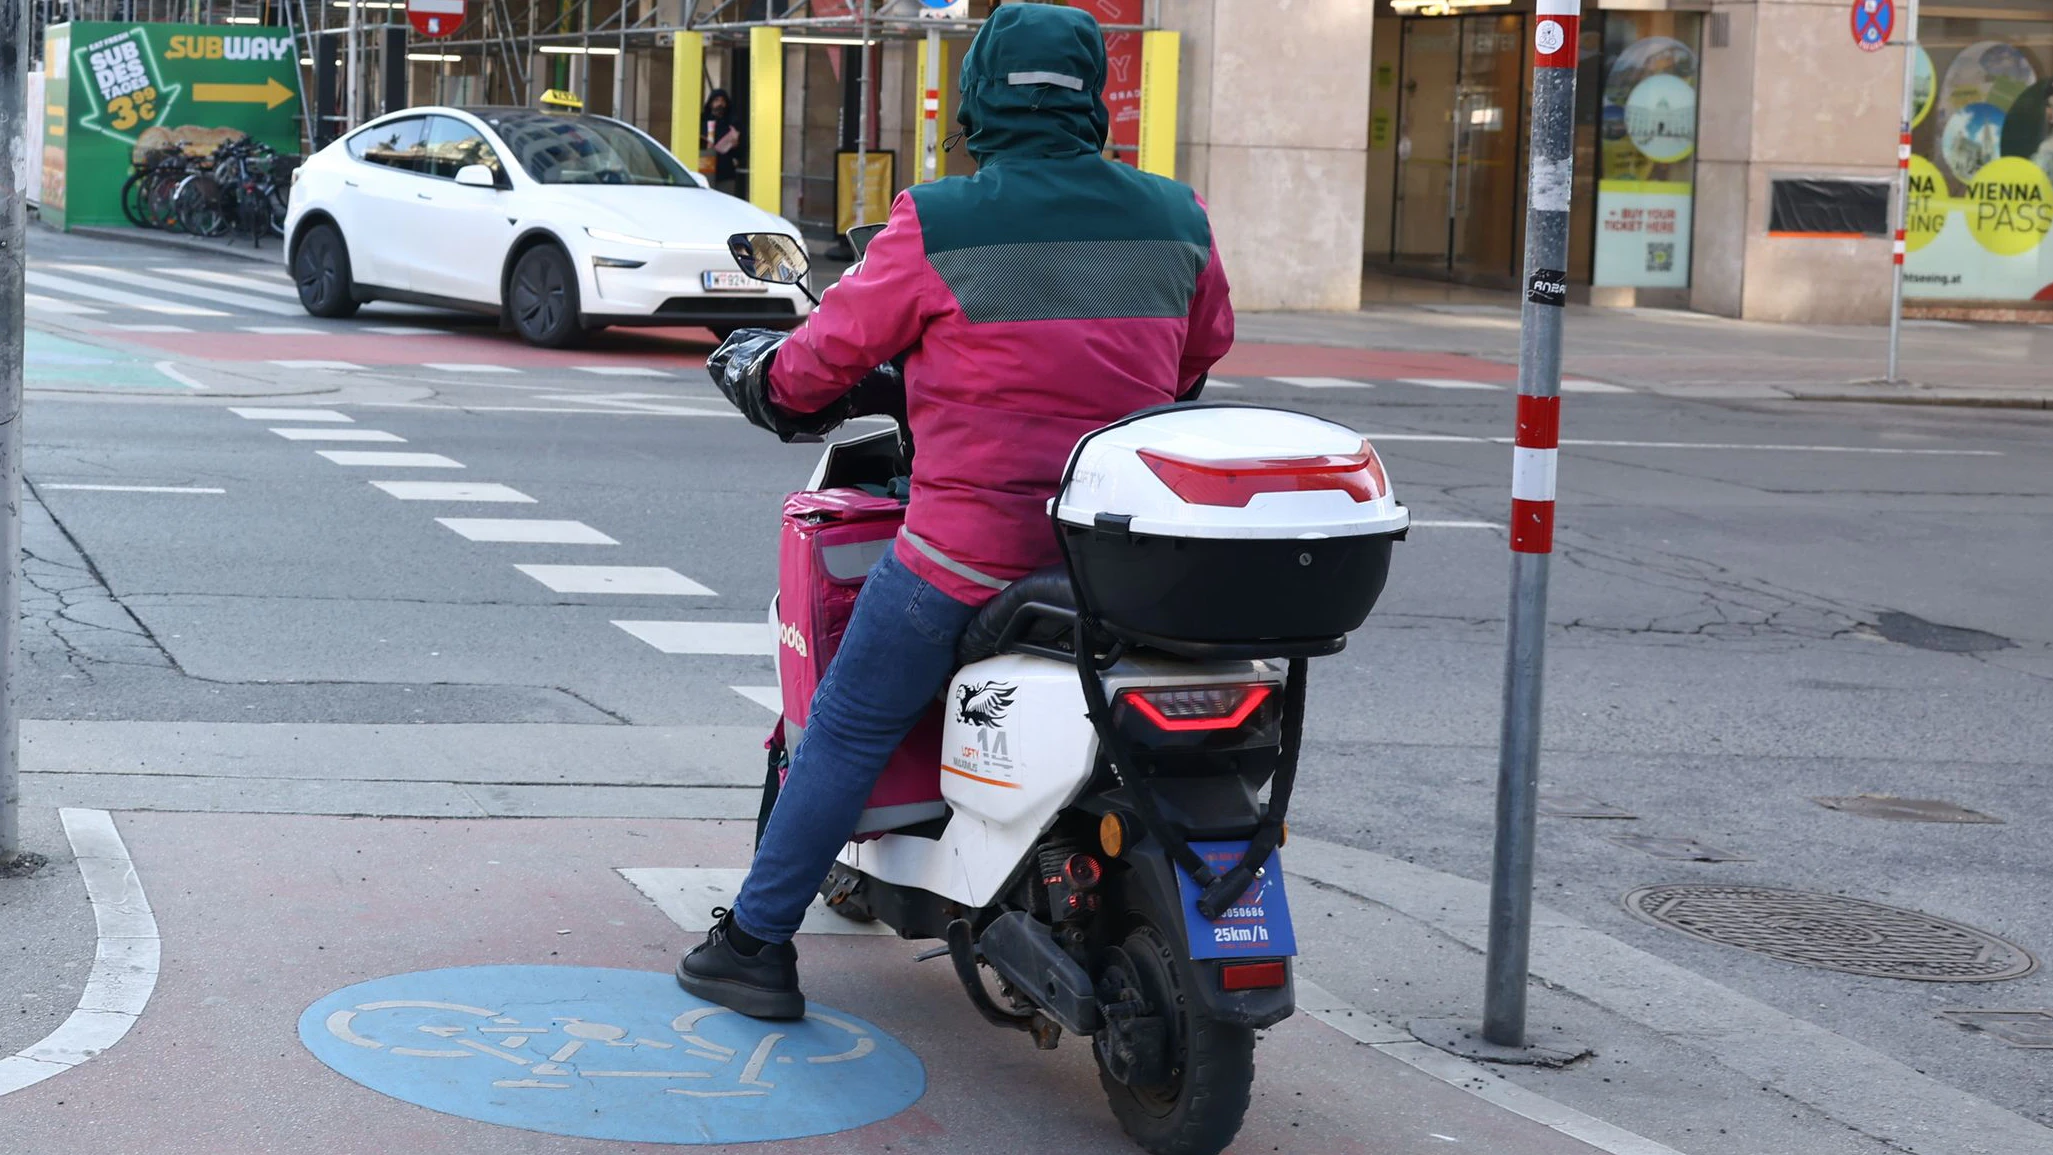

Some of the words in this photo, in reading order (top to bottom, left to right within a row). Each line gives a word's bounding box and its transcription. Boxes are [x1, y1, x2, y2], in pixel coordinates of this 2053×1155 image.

[90, 40, 140, 71] SUB
[164, 35, 293, 61] SUBWAY
[95, 58, 145, 89] DES
[1966, 182, 2043, 202] VIENNA
[1622, 209, 1643, 219] BUY
[1647, 209, 1676, 219] YOUR
[1976, 202, 2053, 234] PASS
[1604, 221, 1642, 232] TICKET
[1647, 222, 1675, 234] HERE
[1214, 924, 1269, 942] 25km/h
